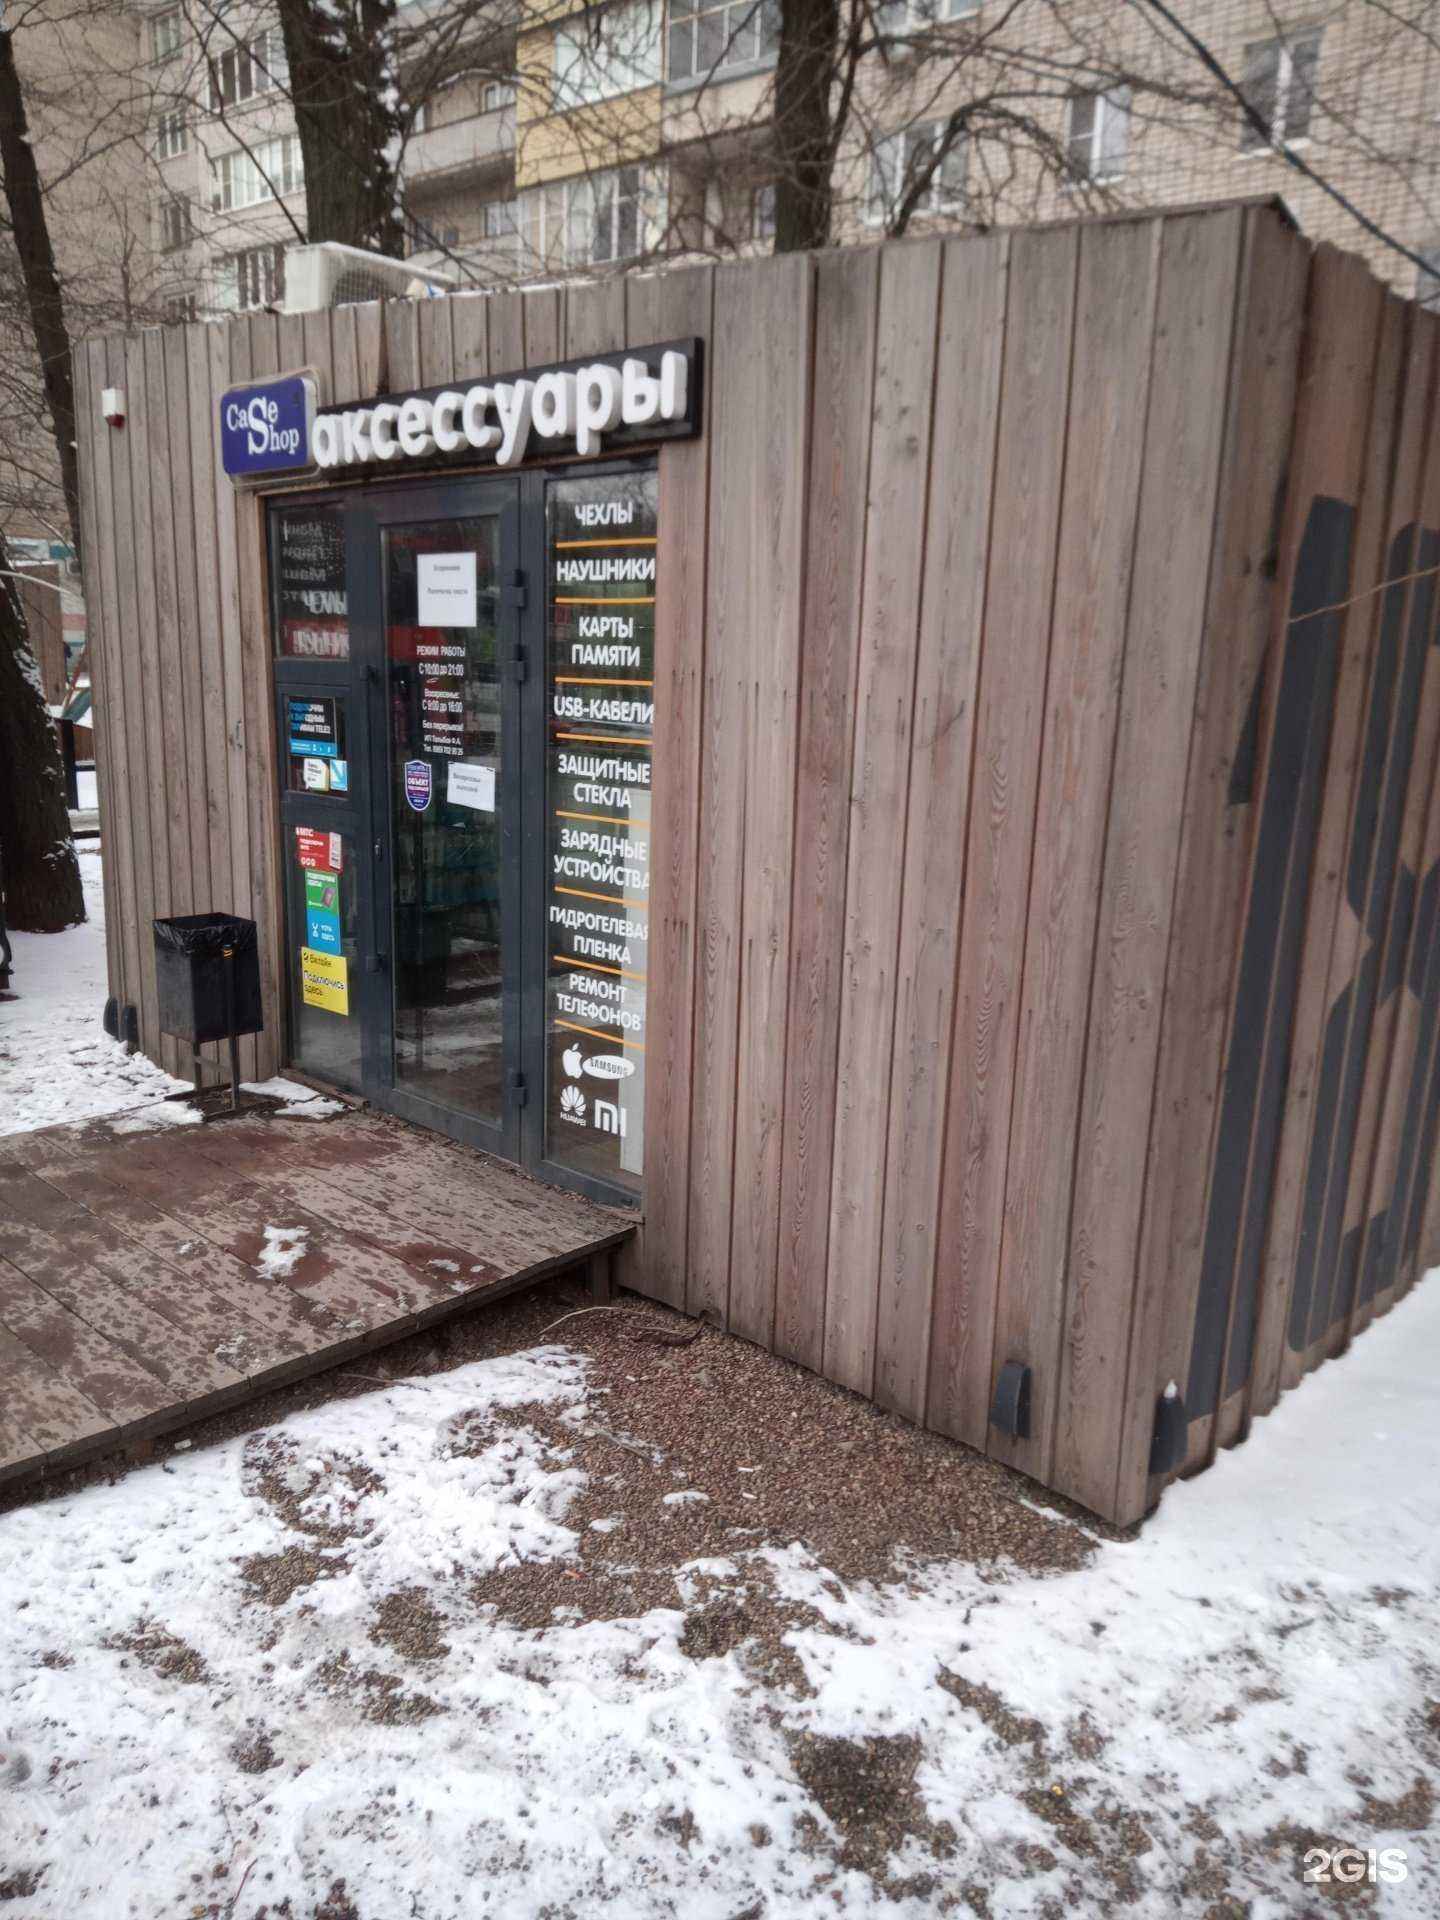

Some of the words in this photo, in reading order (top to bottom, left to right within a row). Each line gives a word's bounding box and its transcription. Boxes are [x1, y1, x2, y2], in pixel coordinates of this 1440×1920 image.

[312, 350, 688, 468] аксессуары
[574, 501, 633, 527] ЧЕХЛЫ
[556, 557, 656, 582] НАУШНИКИ
[578, 616, 634, 639] КАРТЫ
[440, 646, 466, 657] РАБОТЫ
[571, 643, 640, 667] ПАМЯТИ
[553, 696, 654, 724] USB-КАБЕЛИ
[557, 754, 651, 784] ЗАЩИТНЫЕ
[573, 782, 632, 809] СТЕКЛА
[560, 828, 647, 862] ЗАРЯДНЫЕ
[573, 935, 632, 965] ПЛЕНКА
[569, 973, 628, 1004] РЕМОНТ
[556, 992, 641, 1031] ТЕЛЕФОНОВ
